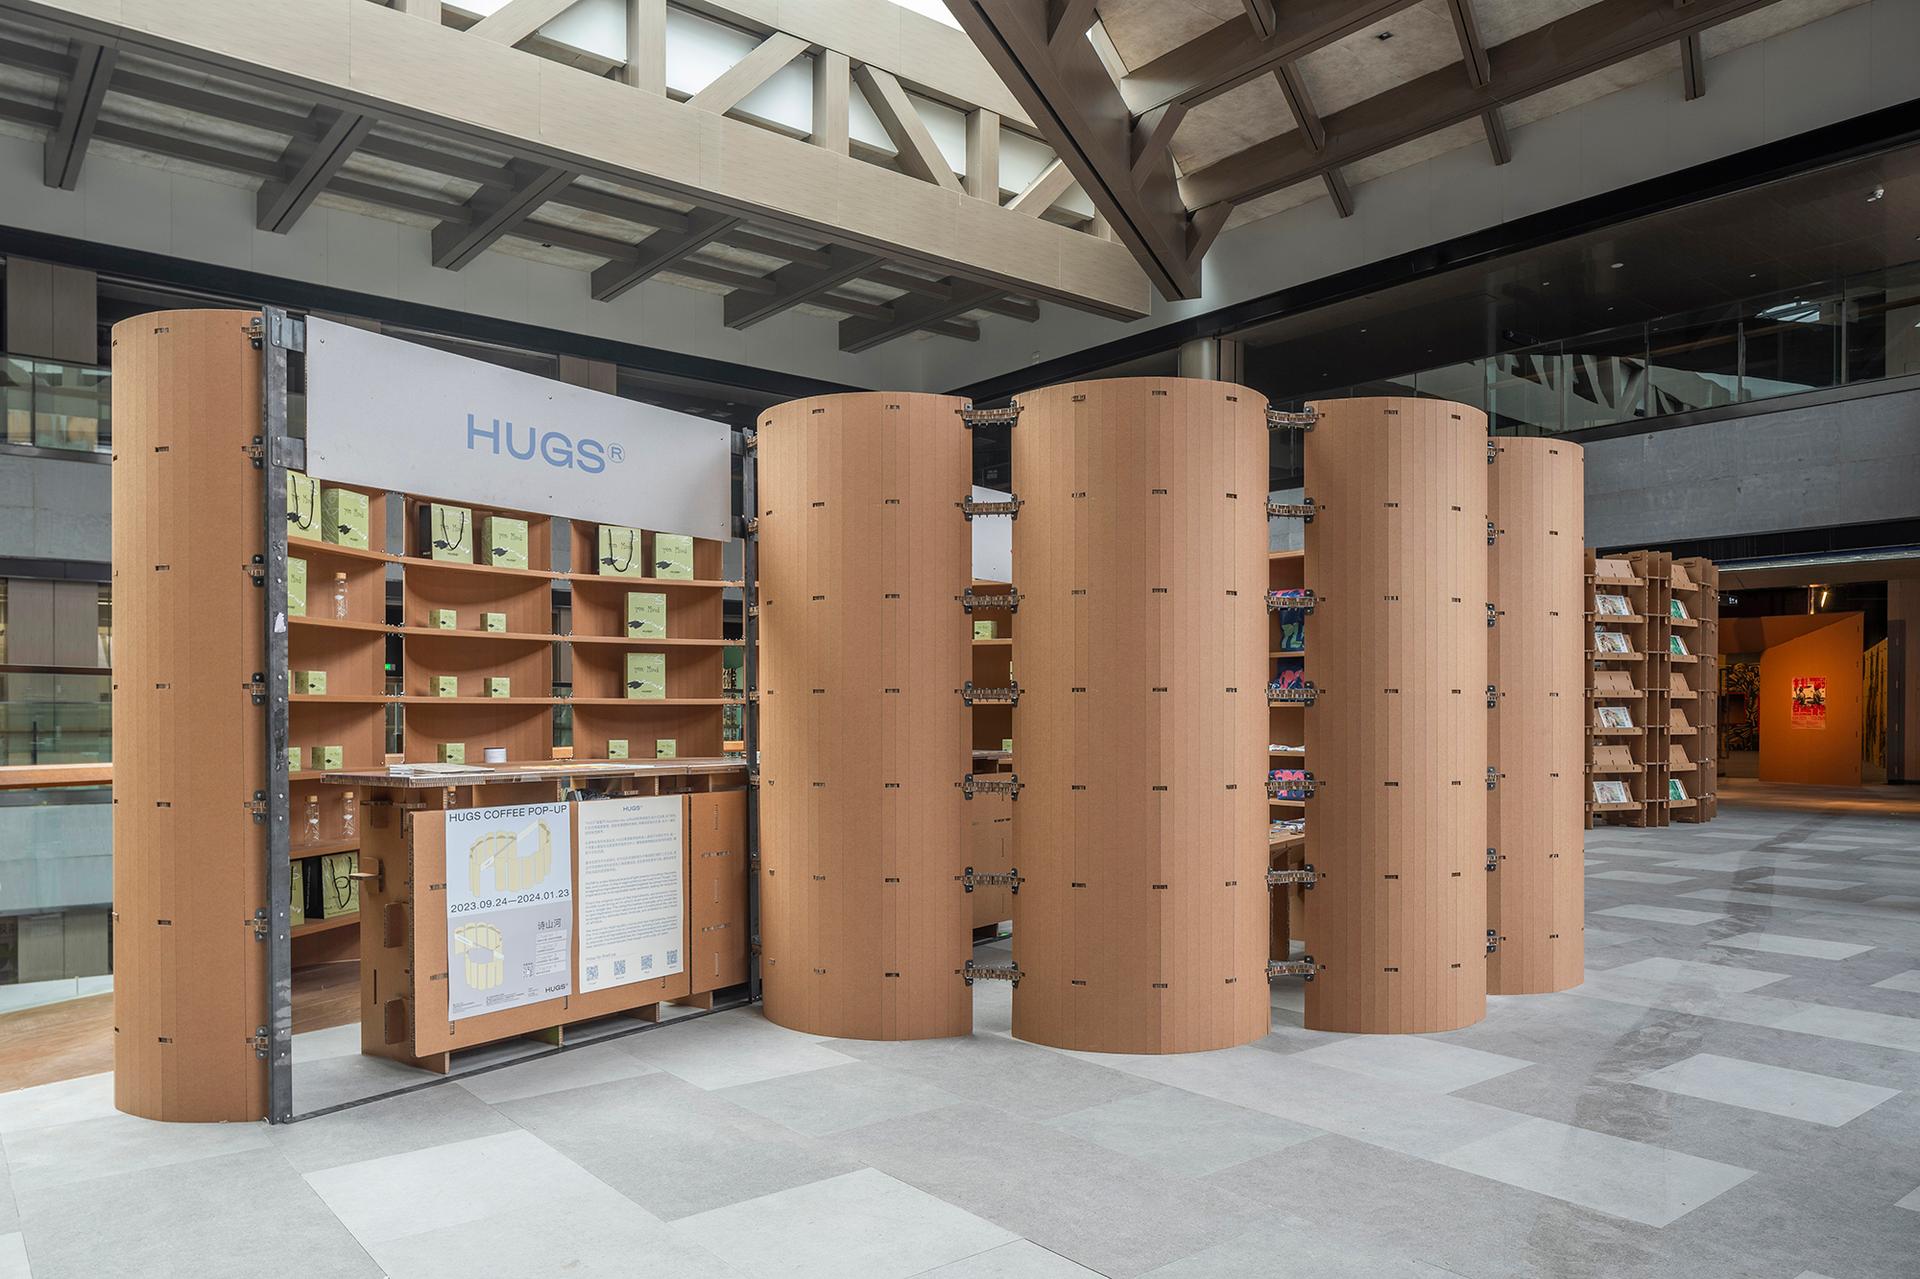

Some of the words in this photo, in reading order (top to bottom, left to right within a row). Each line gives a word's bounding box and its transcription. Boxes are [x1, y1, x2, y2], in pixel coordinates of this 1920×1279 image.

[449, 812, 481, 822] HUGS
[484, 808, 526, 820] COFFEE
[528, 805, 567, 816] POP-UP
